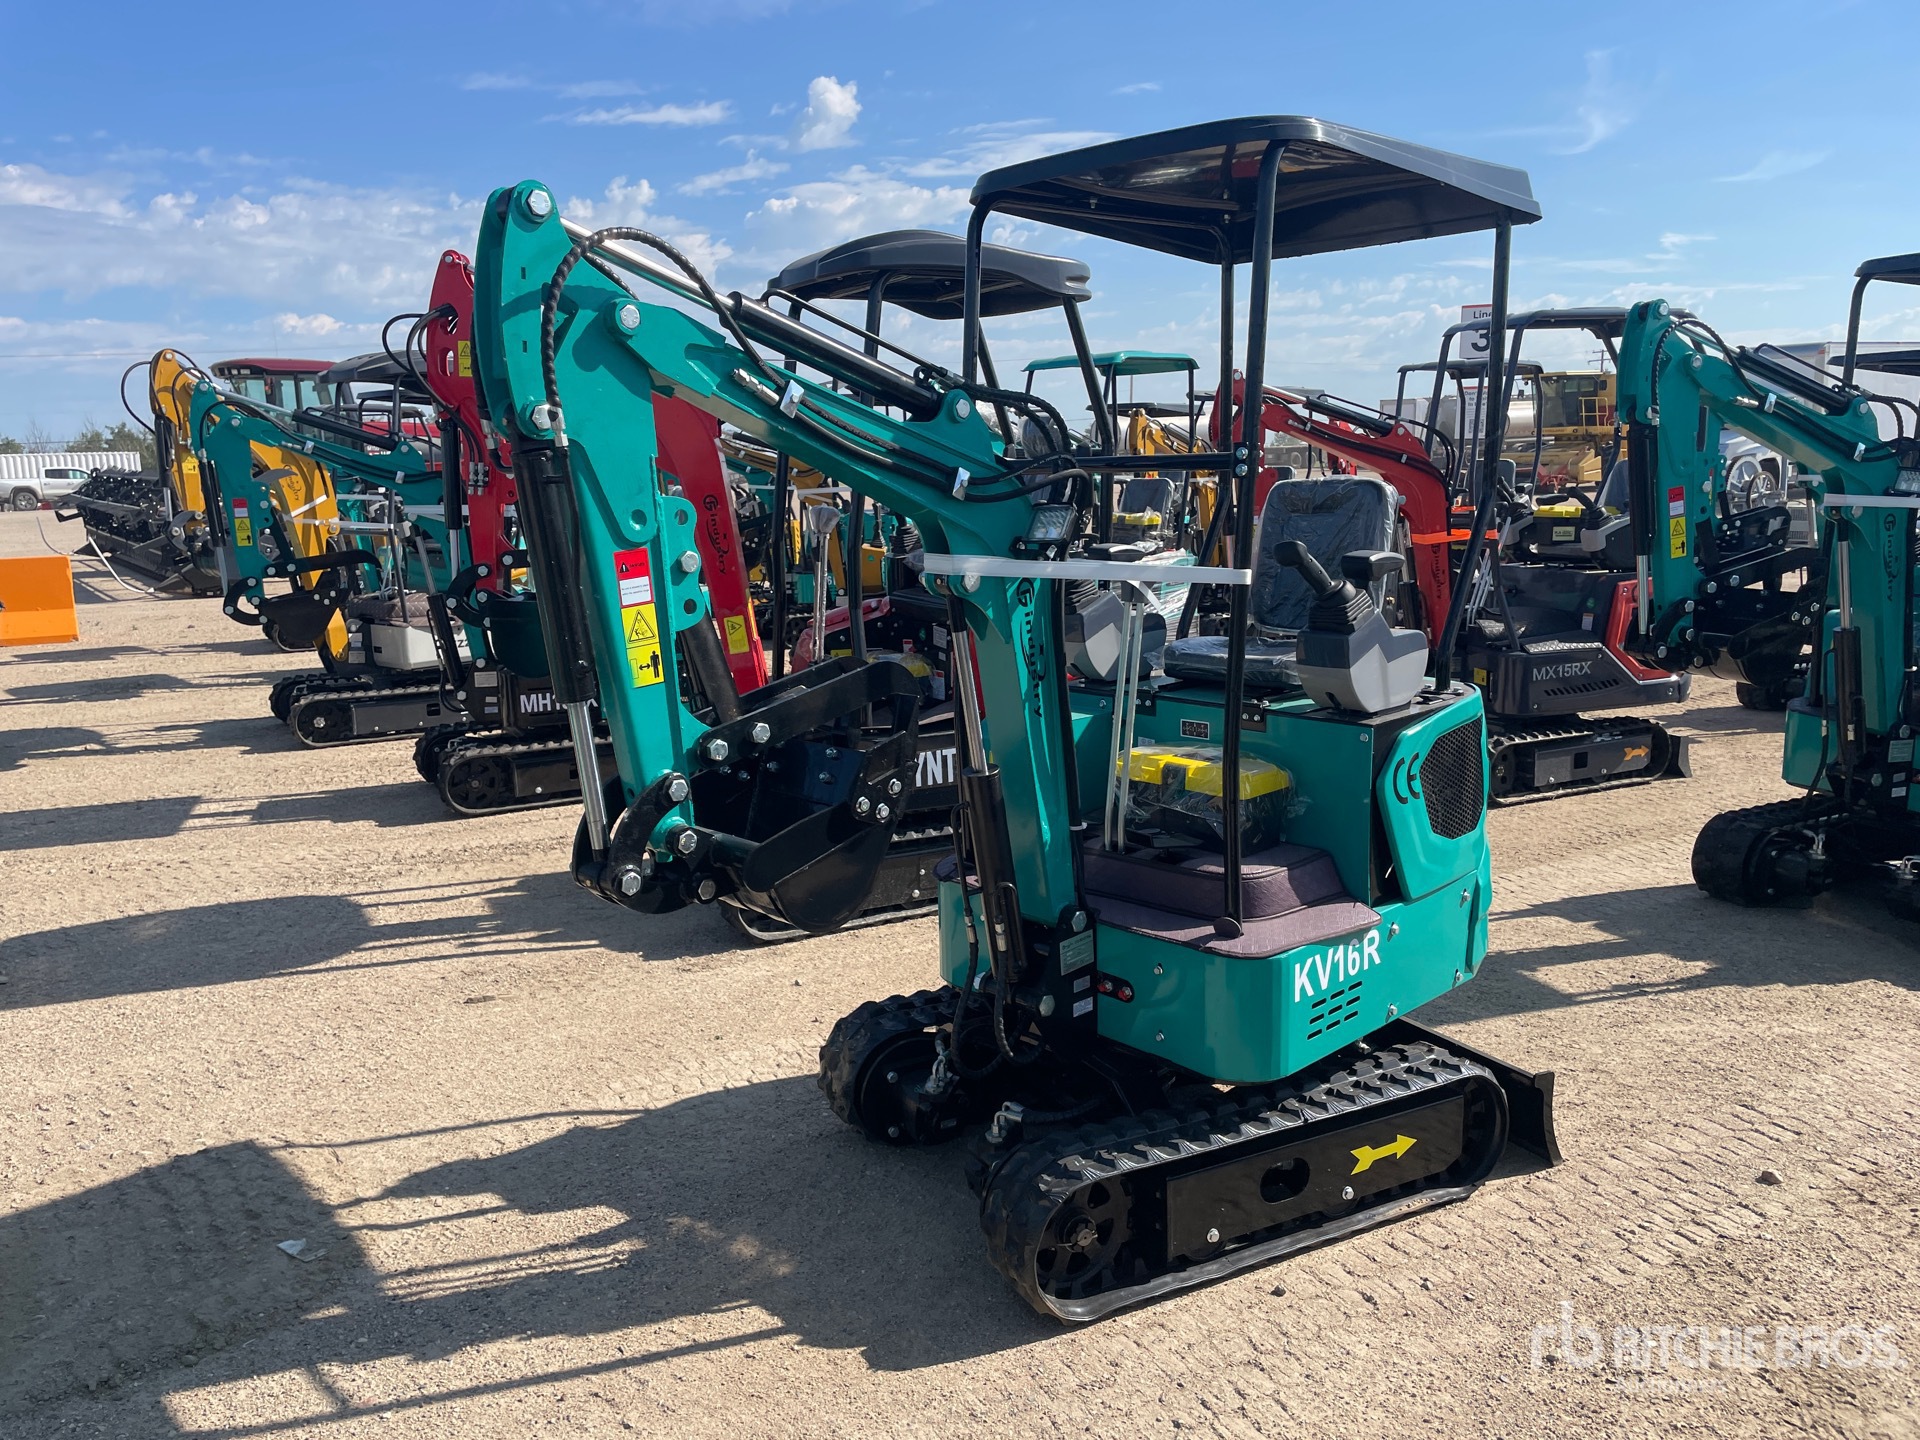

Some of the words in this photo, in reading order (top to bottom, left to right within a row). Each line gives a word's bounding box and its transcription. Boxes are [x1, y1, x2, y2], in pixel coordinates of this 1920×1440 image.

[1532, 660, 1593, 681] MX15RX
[1393, 752, 1420, 804] CE
[1294, 928, 1382, 1003] KV16R
